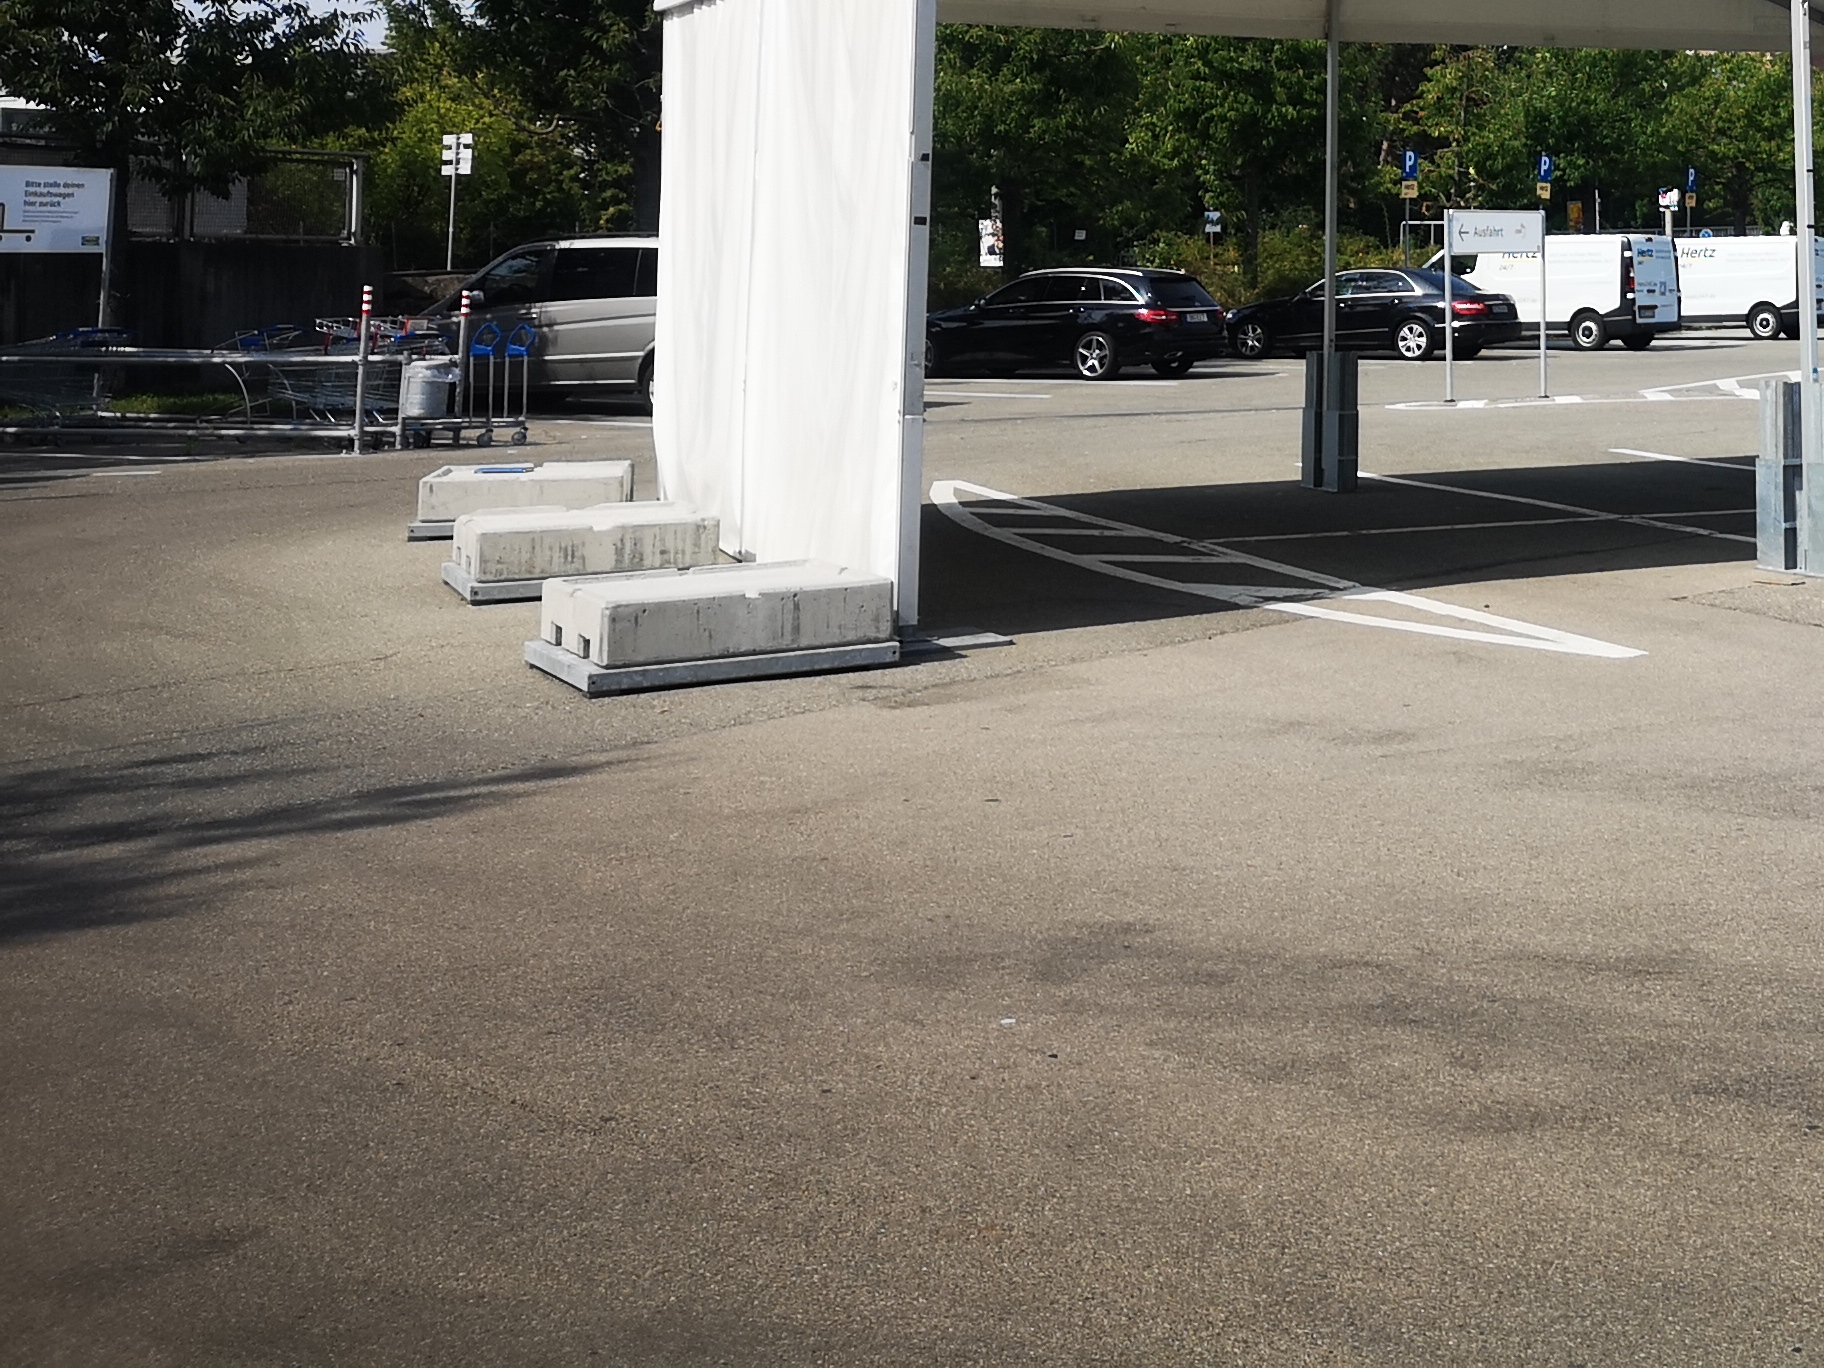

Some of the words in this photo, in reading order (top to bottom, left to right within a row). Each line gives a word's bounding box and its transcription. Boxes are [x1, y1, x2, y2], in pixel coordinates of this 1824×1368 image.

[1405, 150, 1415, 173] P
[1541, 155, 1550, 176] P
[1688, 167, 1695, 186] P
[1473, 226, 1504, 238] Ausfahrt
[1680, 247, 1717, 258] Hertz
